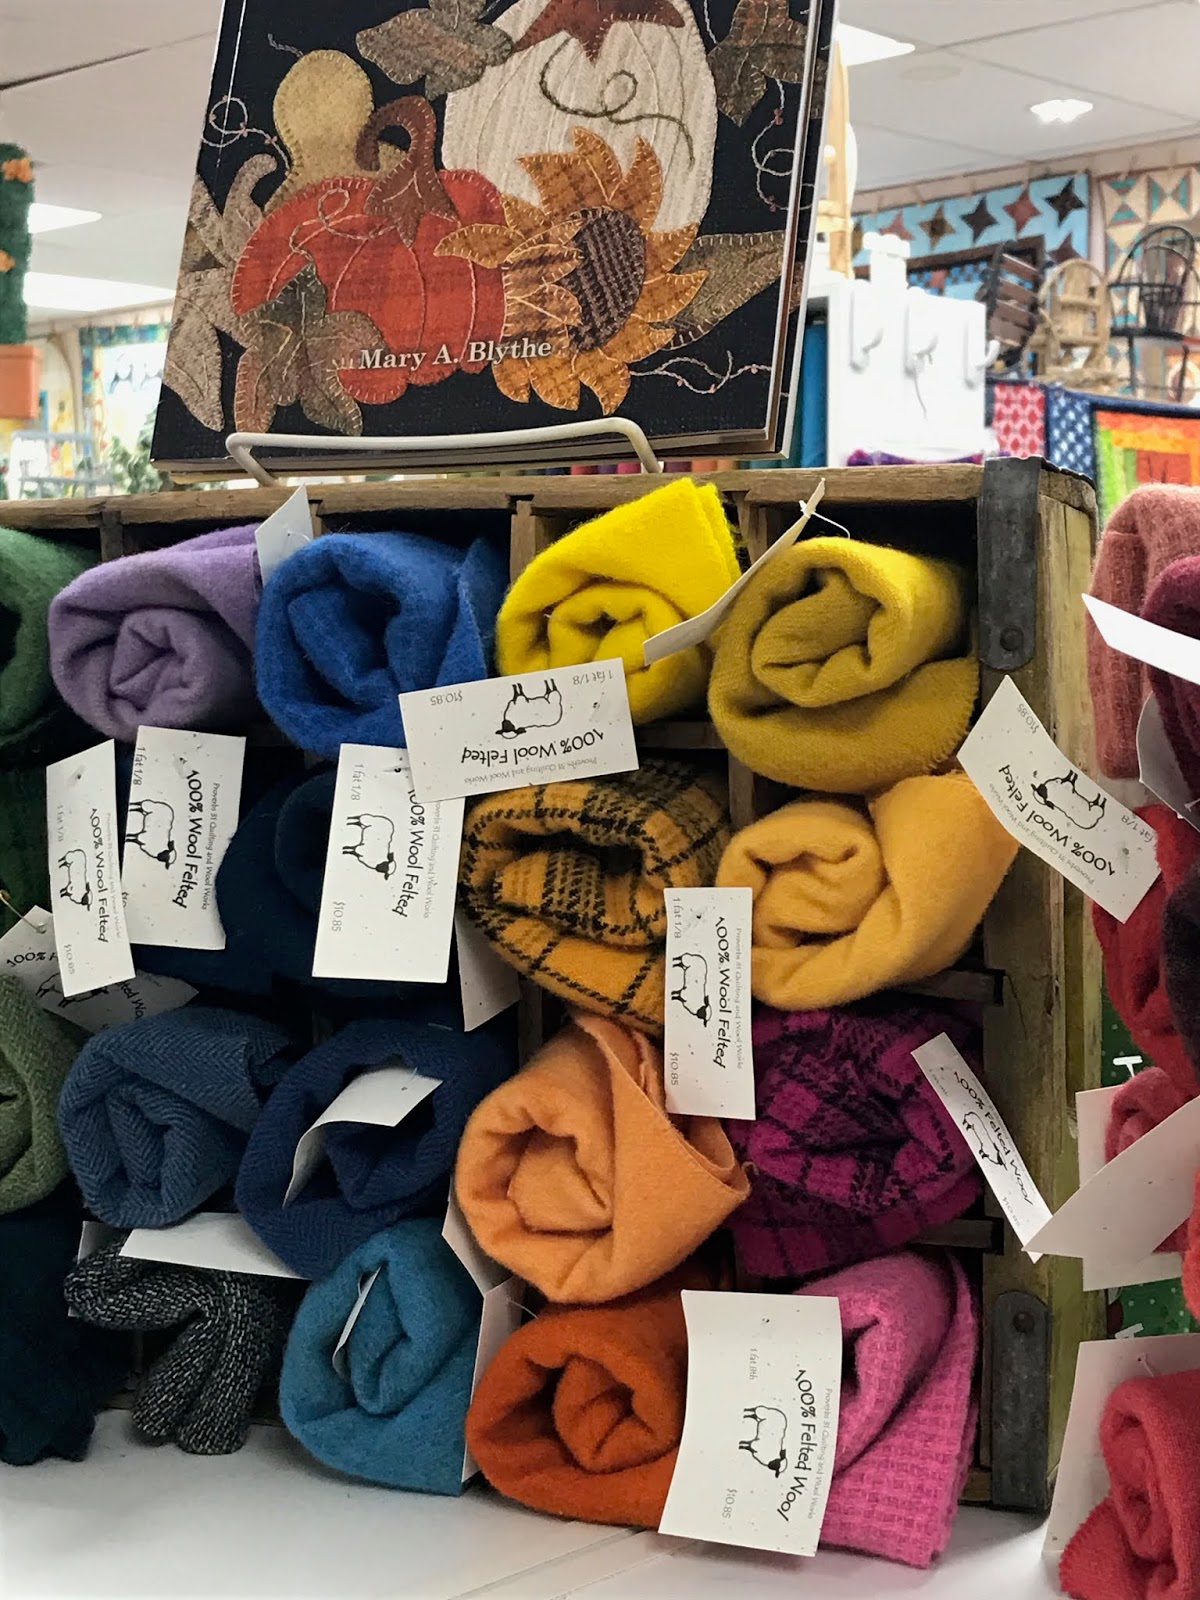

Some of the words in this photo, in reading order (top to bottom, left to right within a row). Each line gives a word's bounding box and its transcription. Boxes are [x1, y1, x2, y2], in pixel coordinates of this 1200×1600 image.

[359, 349, 427, 371] Mary
[432, 344, 460, 364] A.
[467, 338, 552, 365] Blythe
[592, 671, 606, 684] fat
[430, 690, 463, 706] $10.85
[1016, 703, 1040, 734] $10.85
[461, 746, 508, 768] Felted
[513, 743, 557, 765] Wool
[560, 728, 604, 754] 100%
[134, 754, 147, 766] fat
[352, 770, 365, 783] fat
[186, 770, 204, 813] 100%
[998, 764, 1028, 812] Felted
[90, 808, 104, 850] 100%
[186, 818, 203, 859] Wool
[1026, 810, 1069, 846] Wool
[1140, 828, 1154, 843] fat
[407, 830, 424, 869] Wool
[1070, 842, 1115, 876] 100%
[95, 851, 108, 893] Wool
[172, 863, 198, 909] Felted
[392, 873, 419, 918] Felted
[673, 905, 684, 918] fat
[97, 898, 110, 943] Felted
[331, 901, 346, 932] $10.85
[715, 916, 730, 964] 100%
[6, 952, 47, 968] 100%
[719, 968, 732, 1014] Wool
[713, 1018, 731, 1069] Felted
[954, 1071, 985, 1110] 100%
[984, 1111, 1011, 1156] Felted
[1010, 1160, 1034, 1206] Wool
[795, 1369, 816, 1418] 100%
[794, 1423, 818, 1471] Felted
[722, 1488, 738, 1519] $10.85
[777, 1476, 808, 1522] Wool
